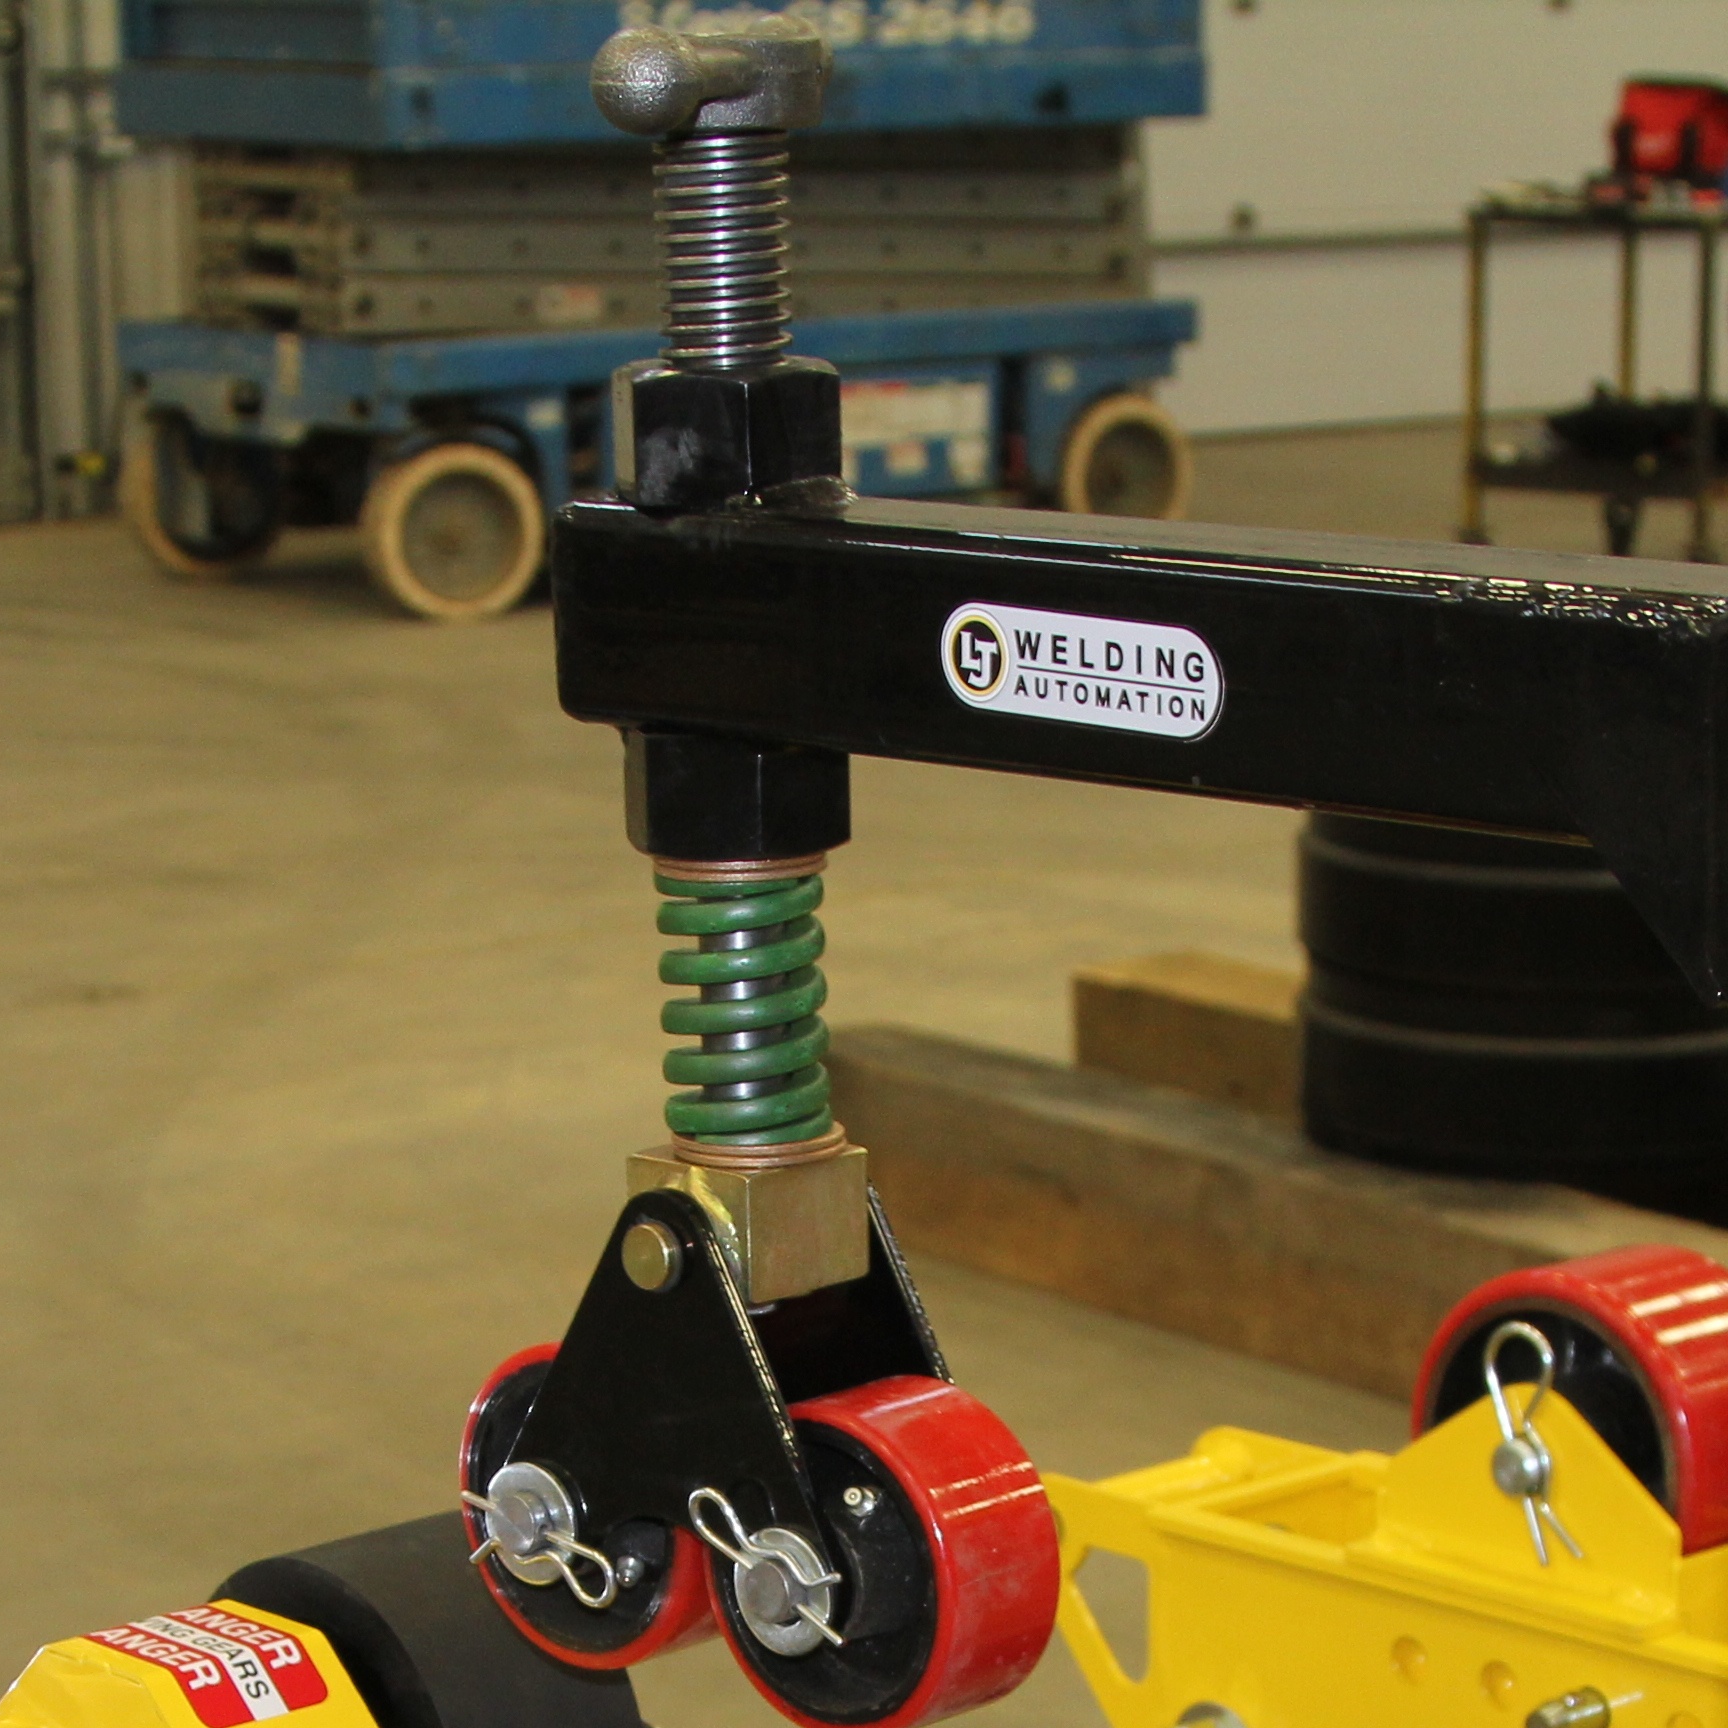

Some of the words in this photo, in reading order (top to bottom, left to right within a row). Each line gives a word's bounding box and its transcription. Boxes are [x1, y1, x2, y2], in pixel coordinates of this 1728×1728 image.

[1013, 628, 1205, 683] WELDING
[1013, 674, 1206, 722] AUTOMATION
[88, 1627, 222, 1691] ANGER
[169, 1606, 303, 1670] ANGER
[191, 1635, 270, 1700] GEARS
